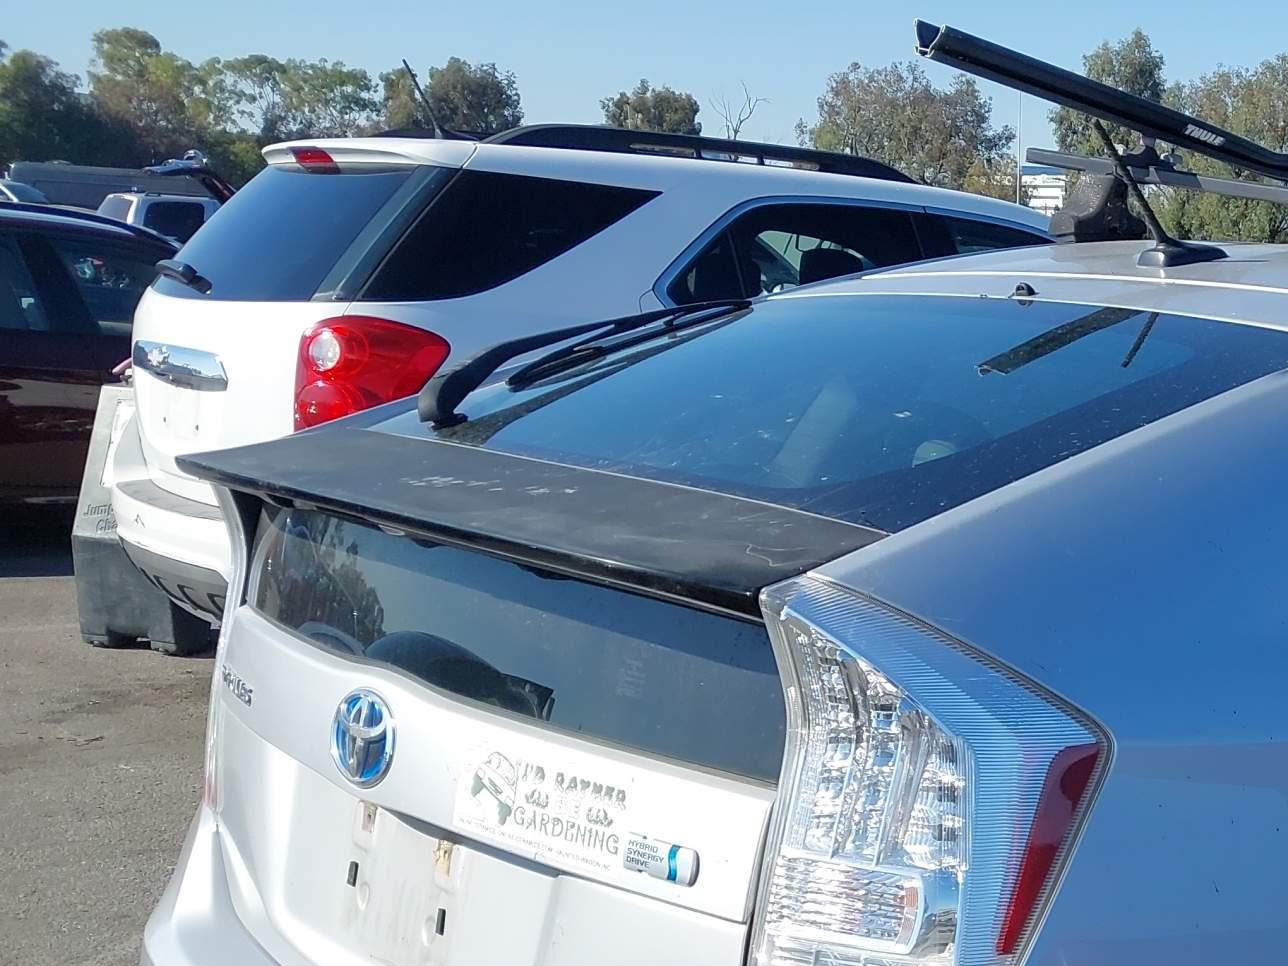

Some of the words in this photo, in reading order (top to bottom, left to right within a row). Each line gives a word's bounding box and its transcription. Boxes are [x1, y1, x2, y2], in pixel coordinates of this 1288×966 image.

[1184, 123, 1226, 146] THULE
[513, 806, 620, 856] GARDENING
[628, 840, 659, 853] HYBRID
[626, 856, 650, 868] DRIVE
[627, 848, 665, 864] SYNERGY
